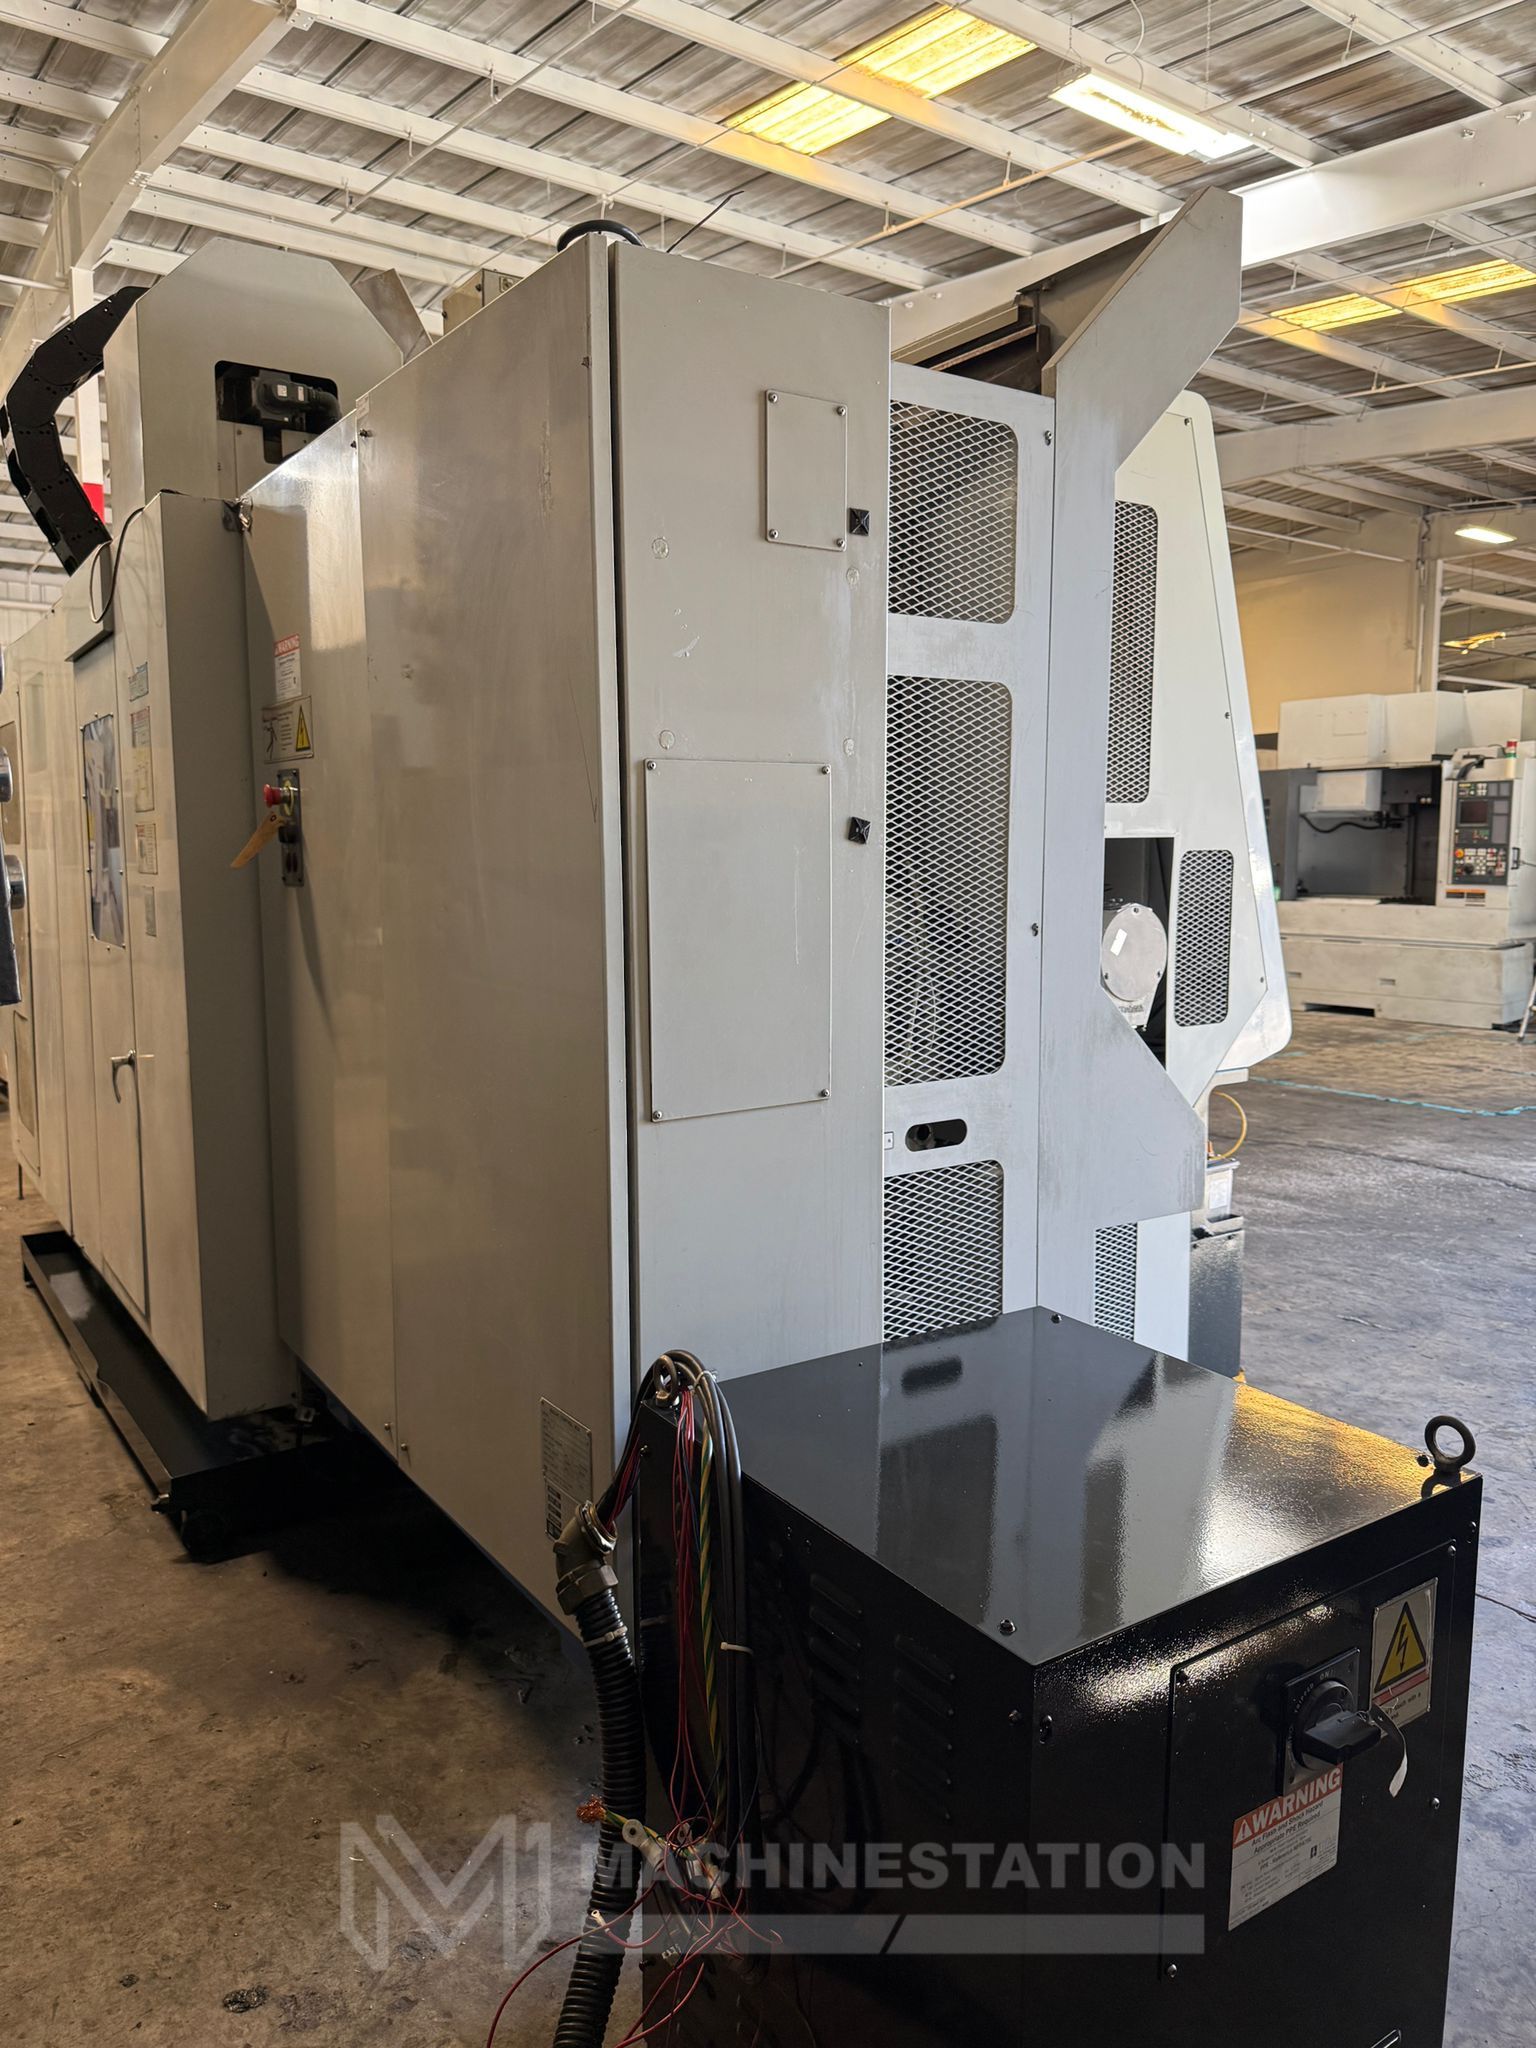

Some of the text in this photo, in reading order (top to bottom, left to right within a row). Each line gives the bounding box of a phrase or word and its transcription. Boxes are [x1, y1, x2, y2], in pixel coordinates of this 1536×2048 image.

[1250, 1767, 1341, 1833] WARNING
[1254, 1831, 1285, 1854] Appropriate
[1285, 1824, 1297, 1836] PPE
[1297, 1810, 1321, 1830] Required
[1262, 1827, 1276, 1841] Flash
[1277, 1822, 1288, 1834] and
[1288, 1812, 1305, 1827] Shock
